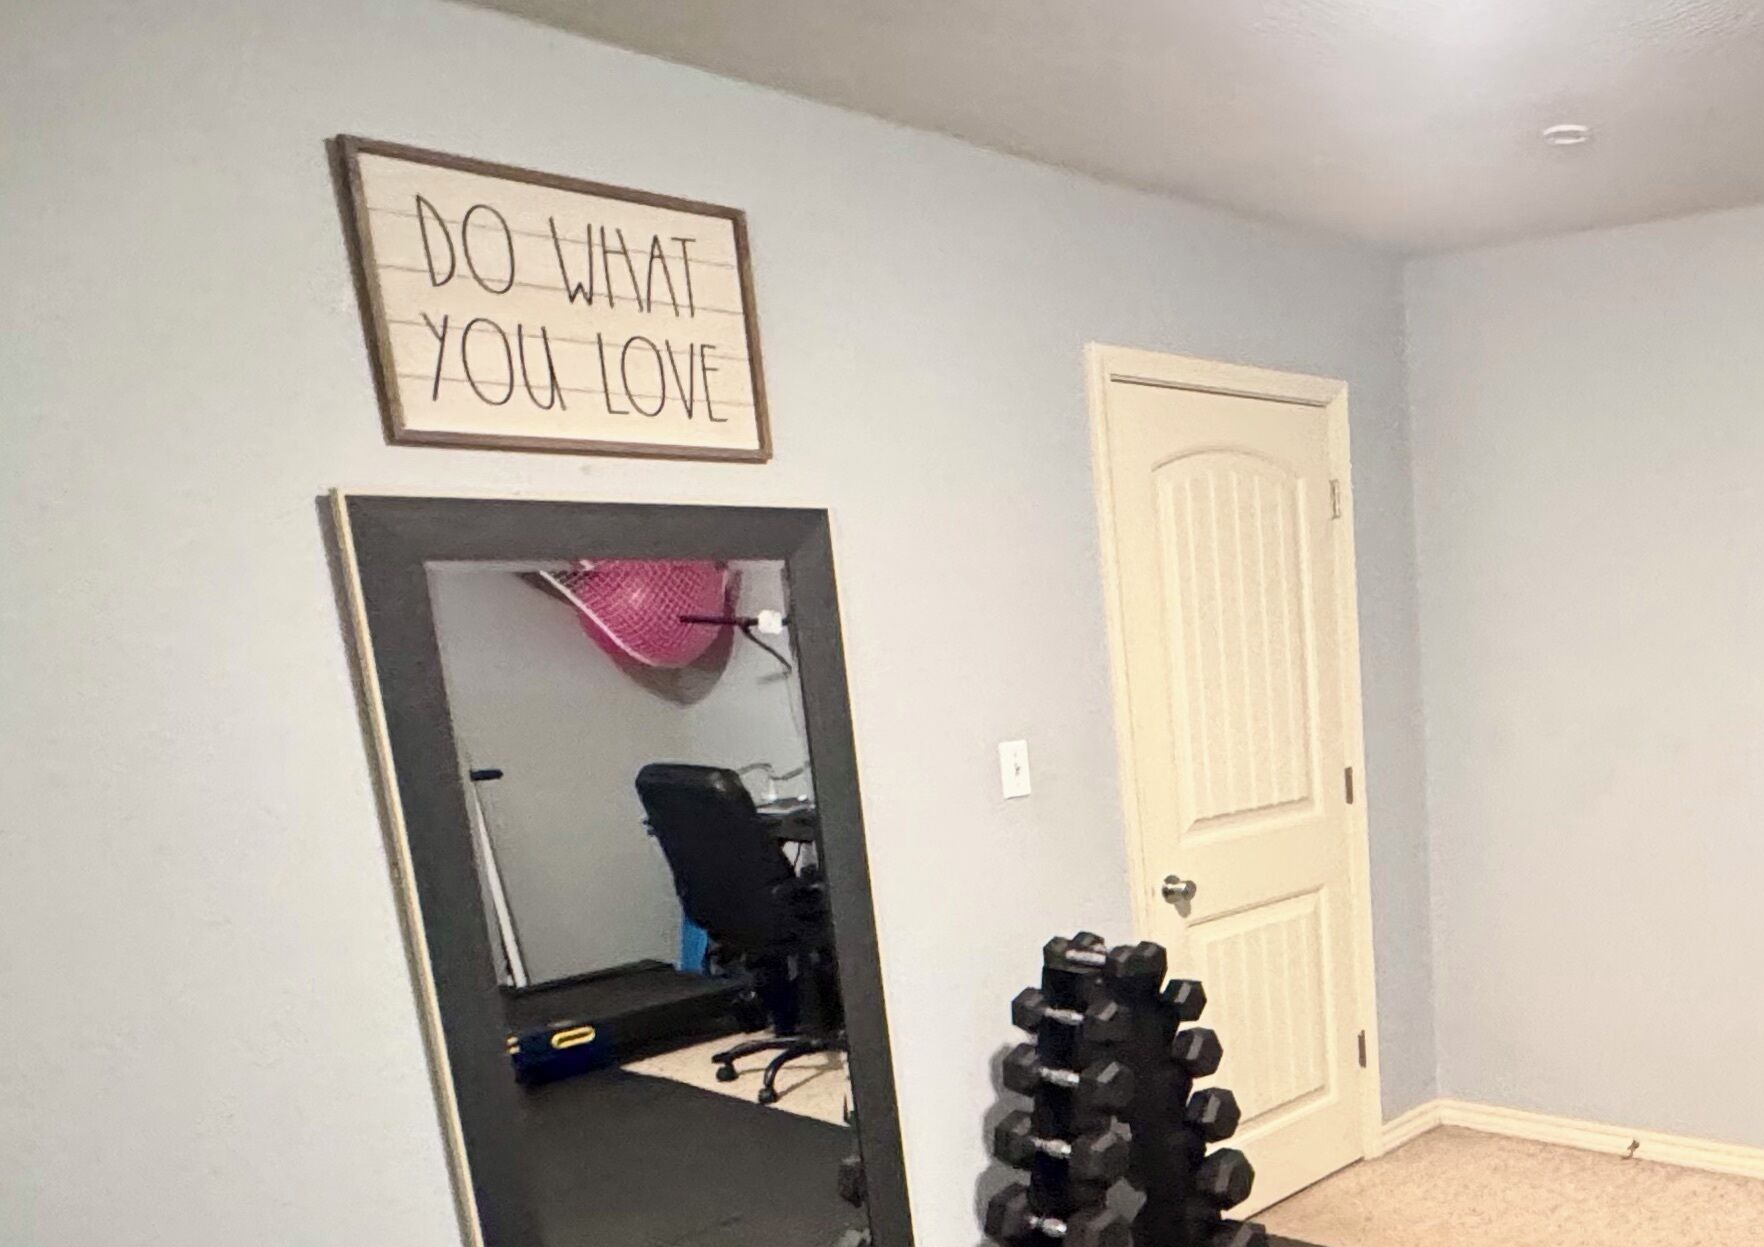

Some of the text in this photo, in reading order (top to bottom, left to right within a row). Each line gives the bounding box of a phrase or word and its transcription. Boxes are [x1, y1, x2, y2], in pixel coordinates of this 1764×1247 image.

[416, 193, 697, 318] DO WHAT
[420, 312, 729, 422] YOU LOVE
